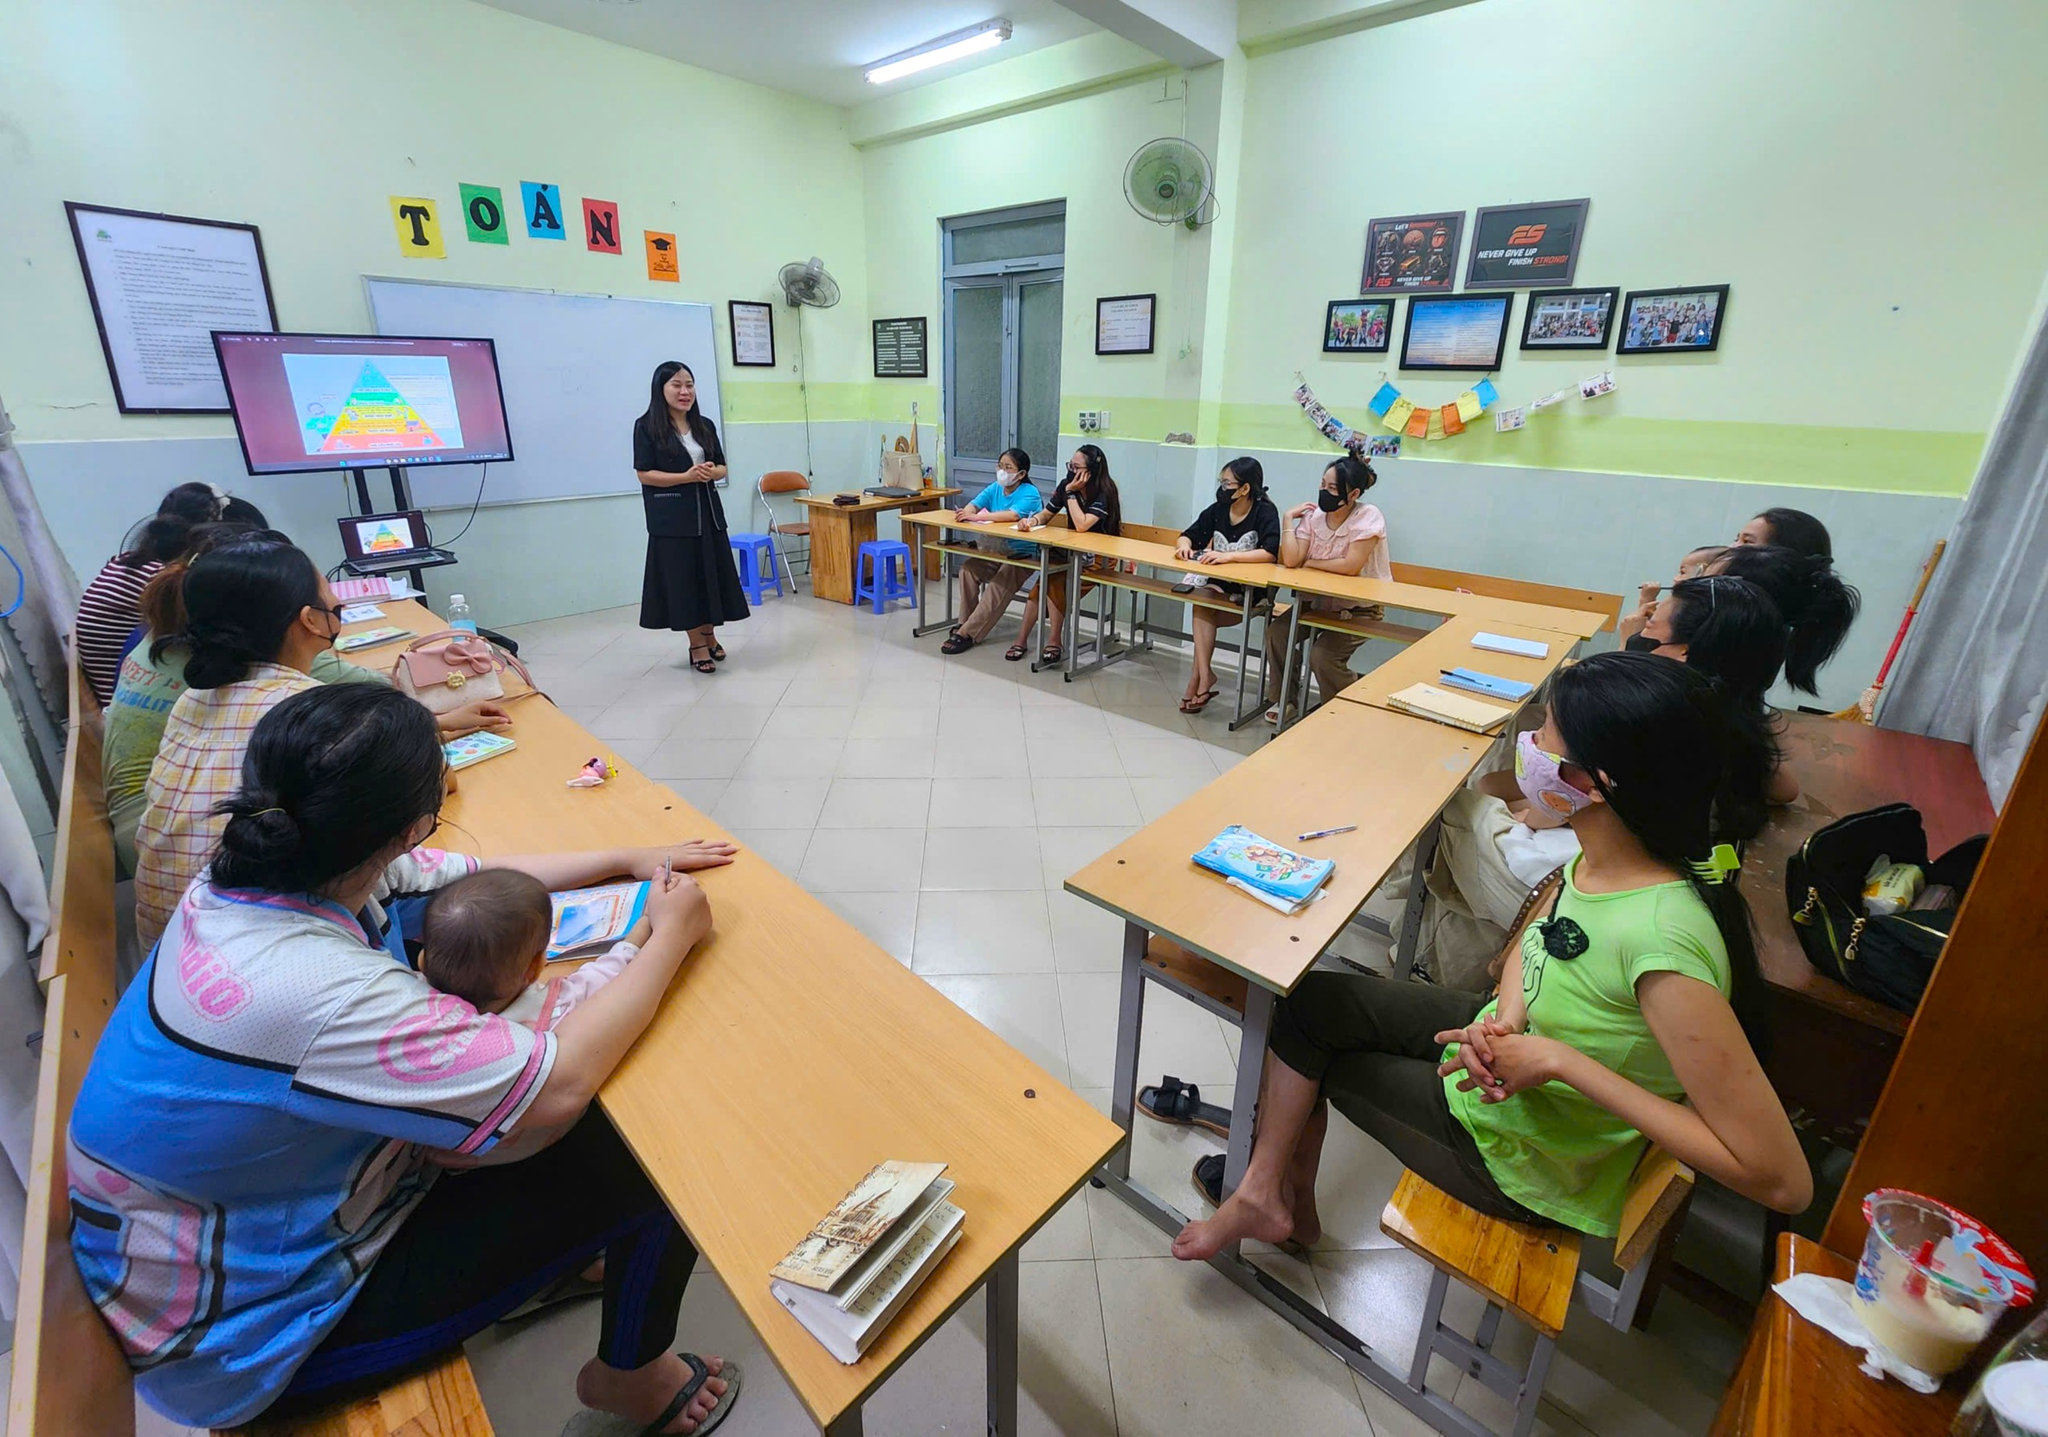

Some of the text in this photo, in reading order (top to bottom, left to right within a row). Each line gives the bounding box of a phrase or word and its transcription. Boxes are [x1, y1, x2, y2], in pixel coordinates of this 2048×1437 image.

[399, 184, 616, 247] TOÁN
[1478, 247, 1538, 259] NEVER GIVE UP
[1507, 257, 1534, 266] FINISH
